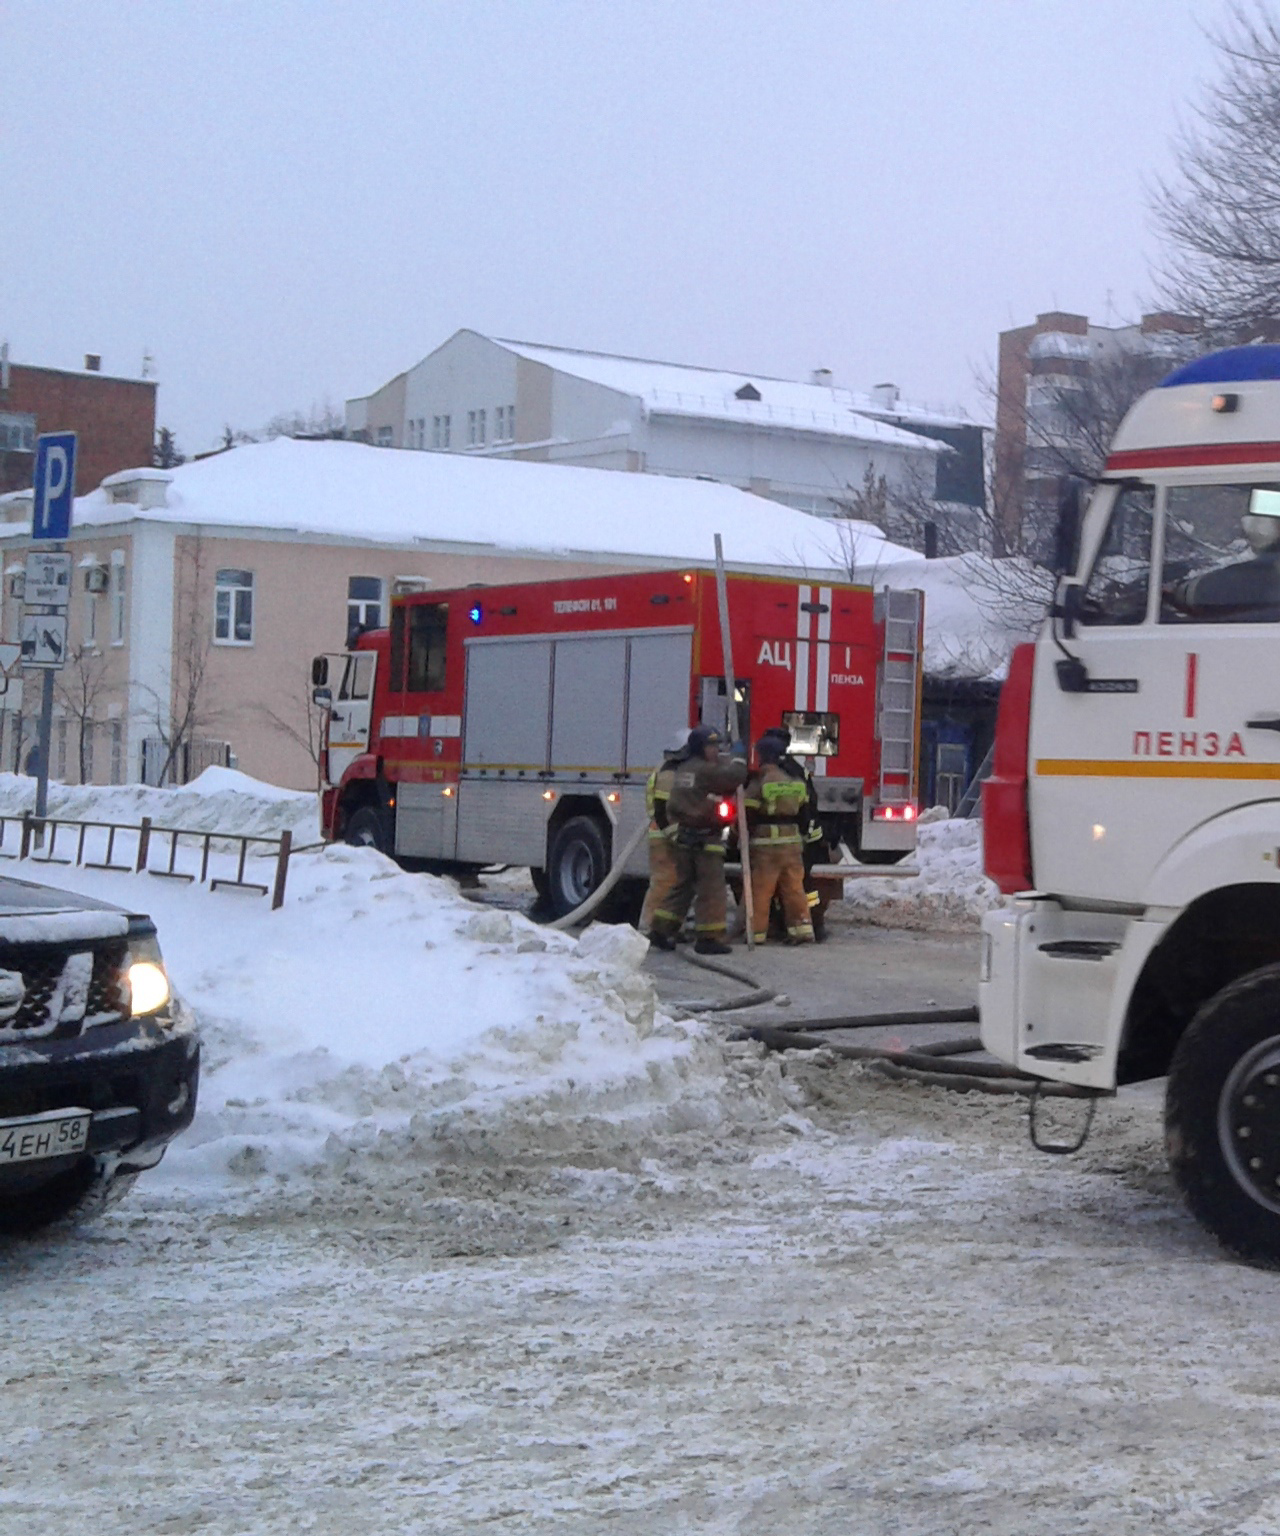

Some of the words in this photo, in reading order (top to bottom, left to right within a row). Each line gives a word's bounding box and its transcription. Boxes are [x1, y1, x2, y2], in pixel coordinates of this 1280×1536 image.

[757, 640, 791, 671] АЦ
[831, 673, 864, 685] ПЕНЗА
[1133, 731, 1246, 757] ПЕНЗА
[58, 1121, 81, 1142] 58
